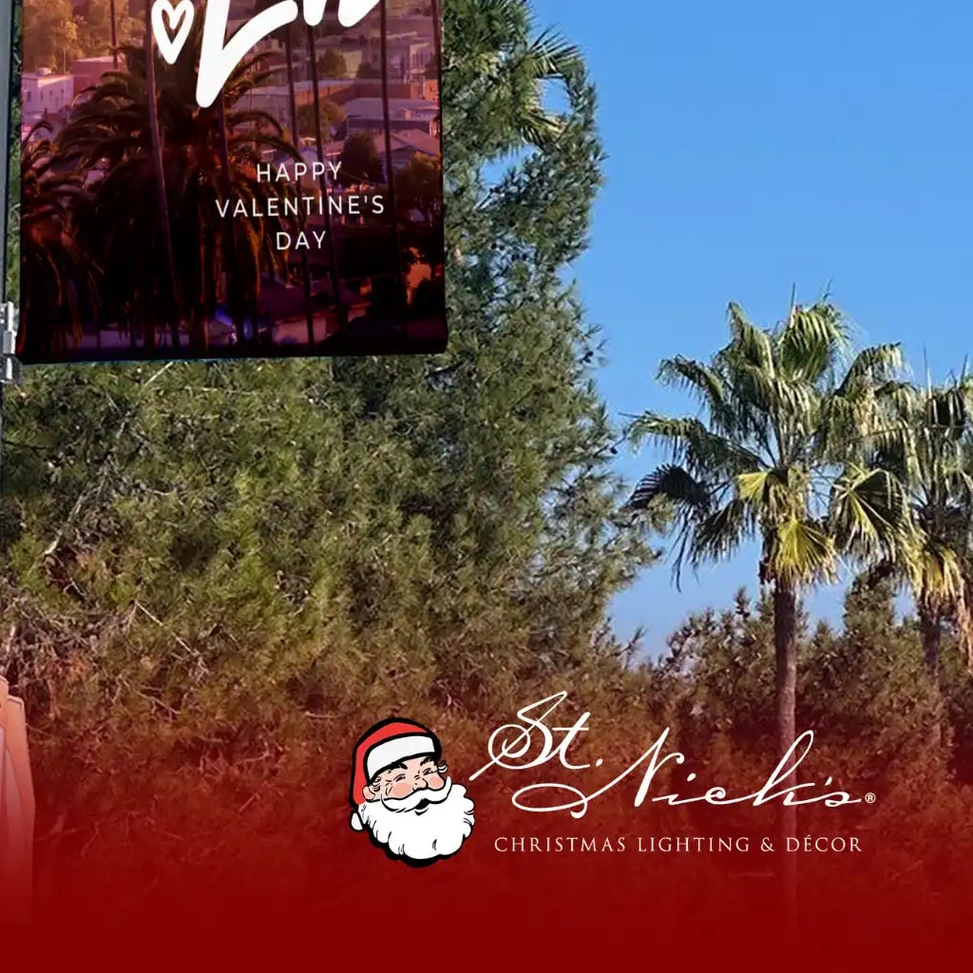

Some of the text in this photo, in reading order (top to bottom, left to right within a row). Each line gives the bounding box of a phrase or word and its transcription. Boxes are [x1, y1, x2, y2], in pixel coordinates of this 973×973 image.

[256, 161, 342, 183] HAPPY
[215, 195, 385, 218] VALENTINE'S
[276, 230, 326, 250] DAY
